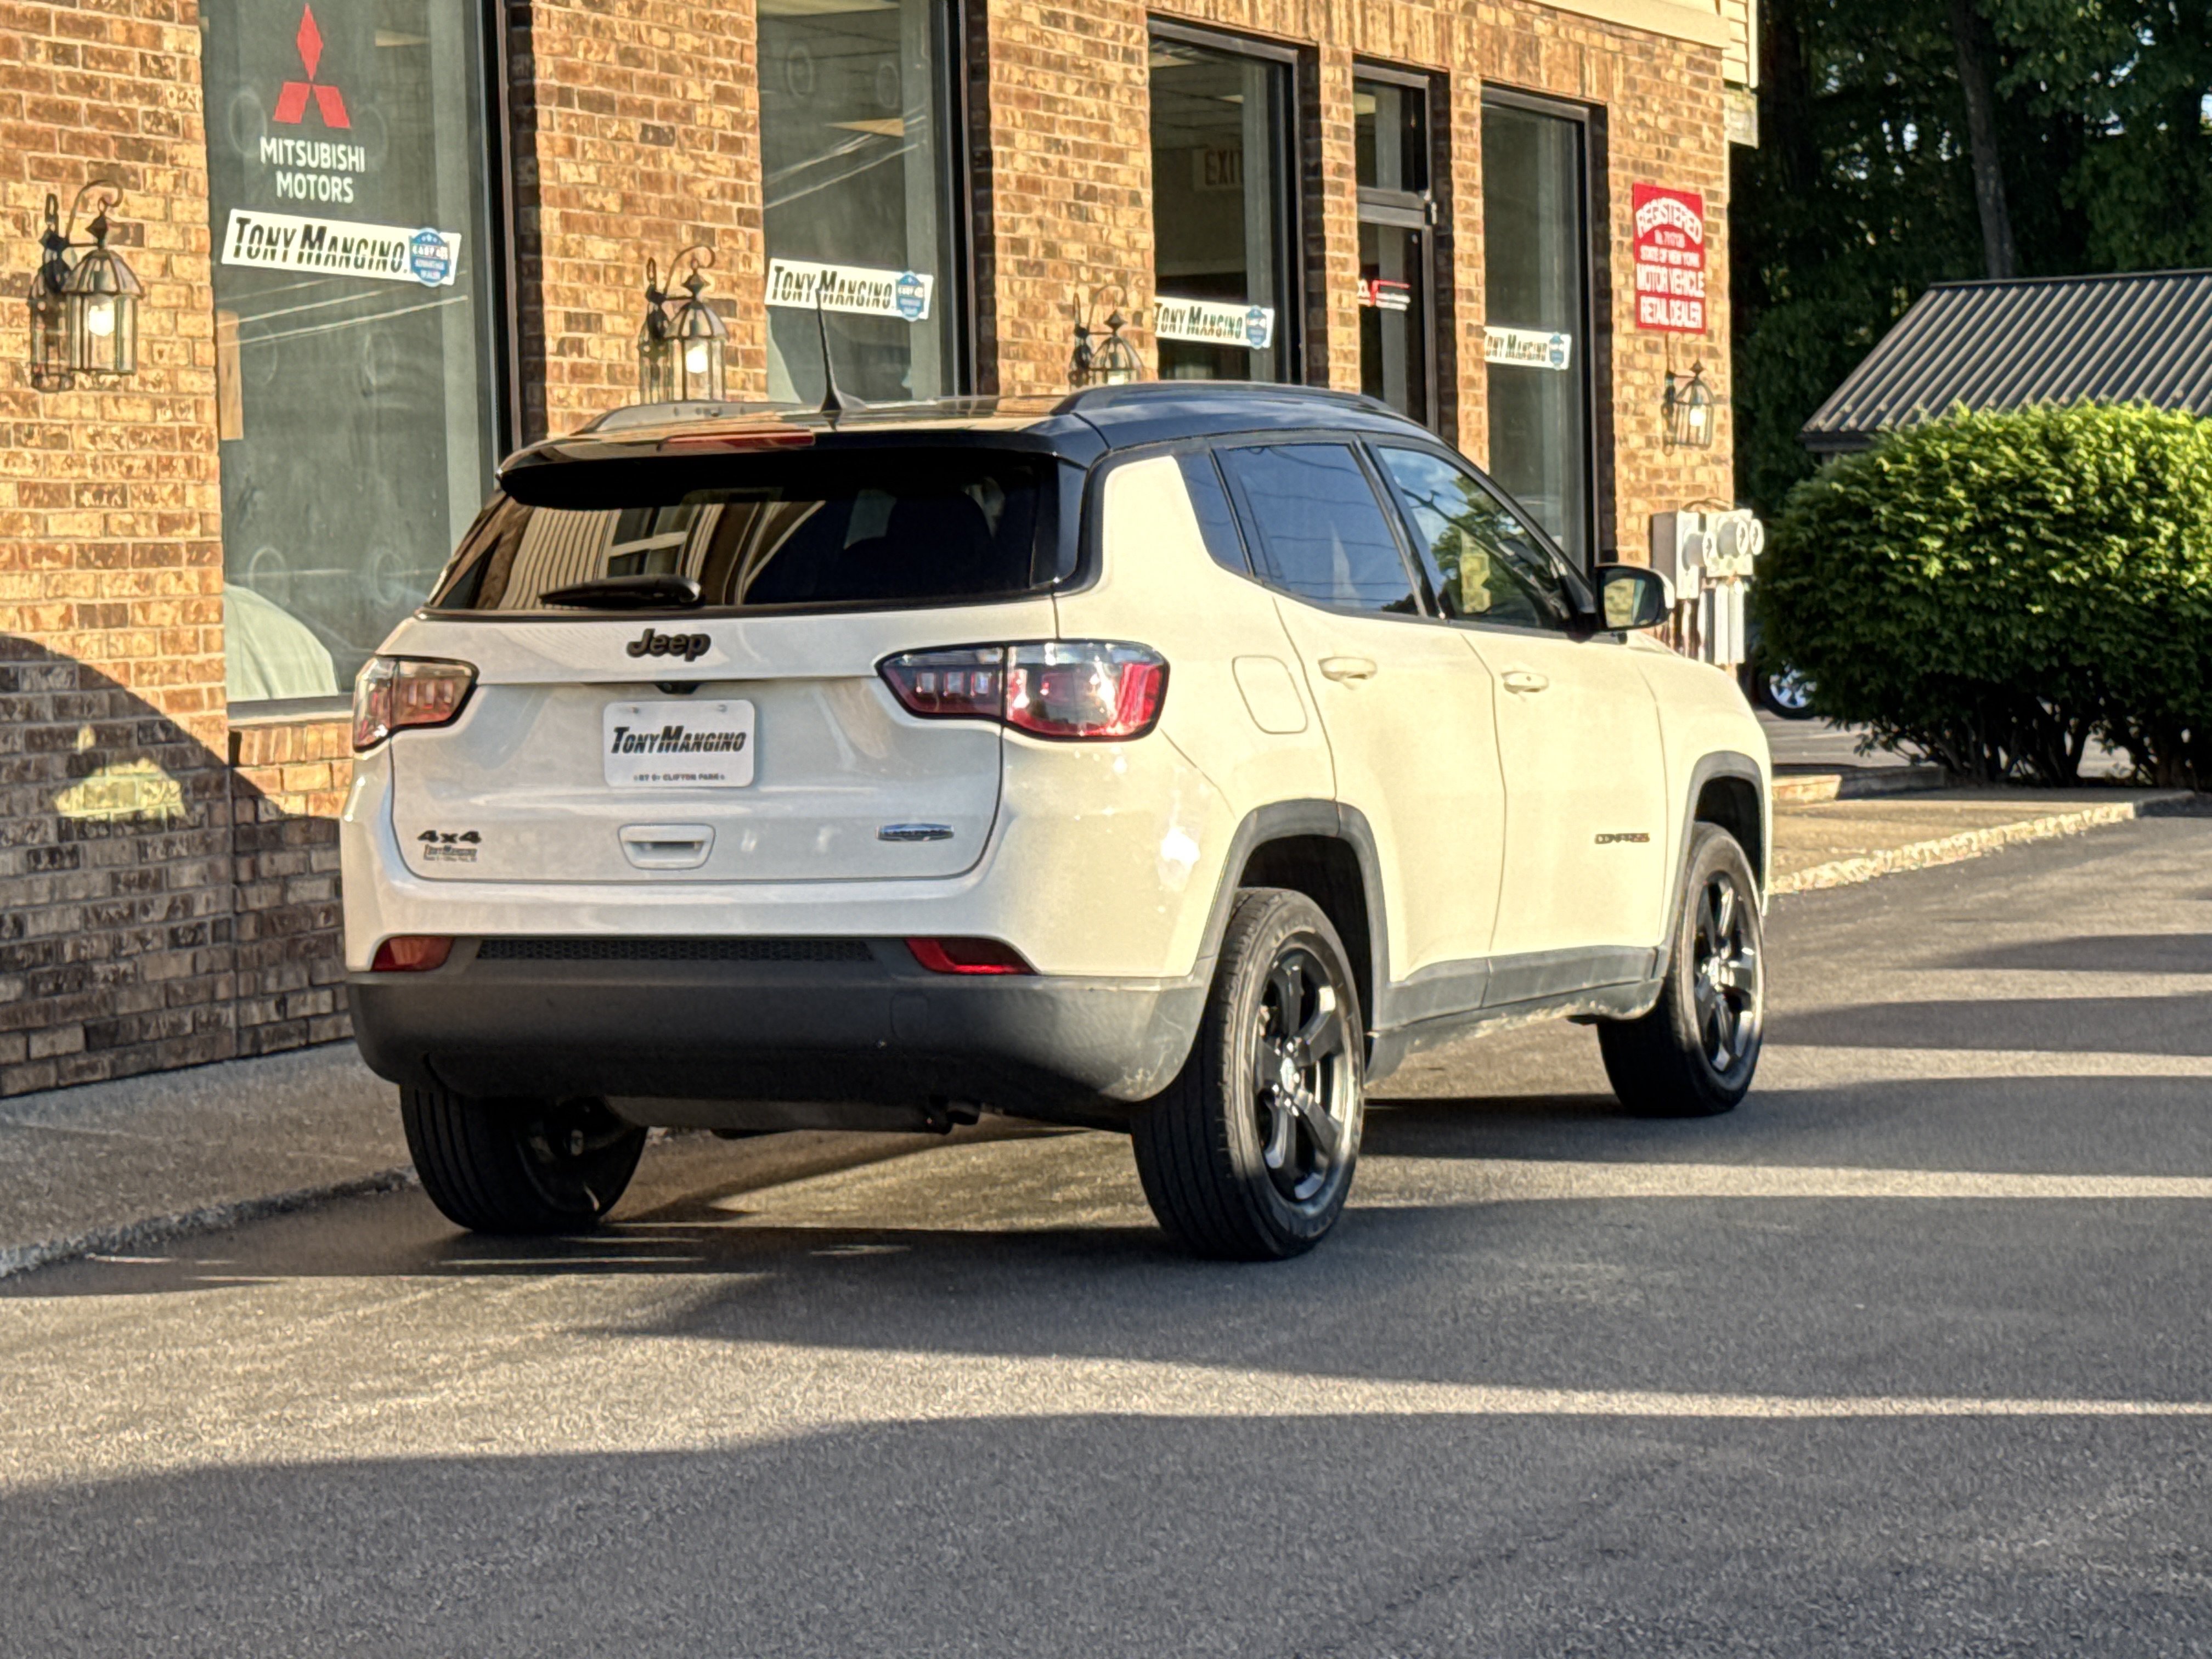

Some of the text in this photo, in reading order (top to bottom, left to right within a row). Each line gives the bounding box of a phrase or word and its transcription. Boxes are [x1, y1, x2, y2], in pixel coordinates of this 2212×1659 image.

[259, 137, 365, 173] MITSUBISHI
[276, 171, 354, 204] MOTORS
[1636, 197, 1703, 245] REGISTERED
[233, 217, 297, 263] TONY
[771, 266, 816, 302] TONY
[1637, 263, 1705, 298] MOTOR VEHICLE
[1640, 295, 1702, 329] RETAIL DEALER
[627, 628, 711, 662] Jeep
[417, 830, 482, 844] 4x4
